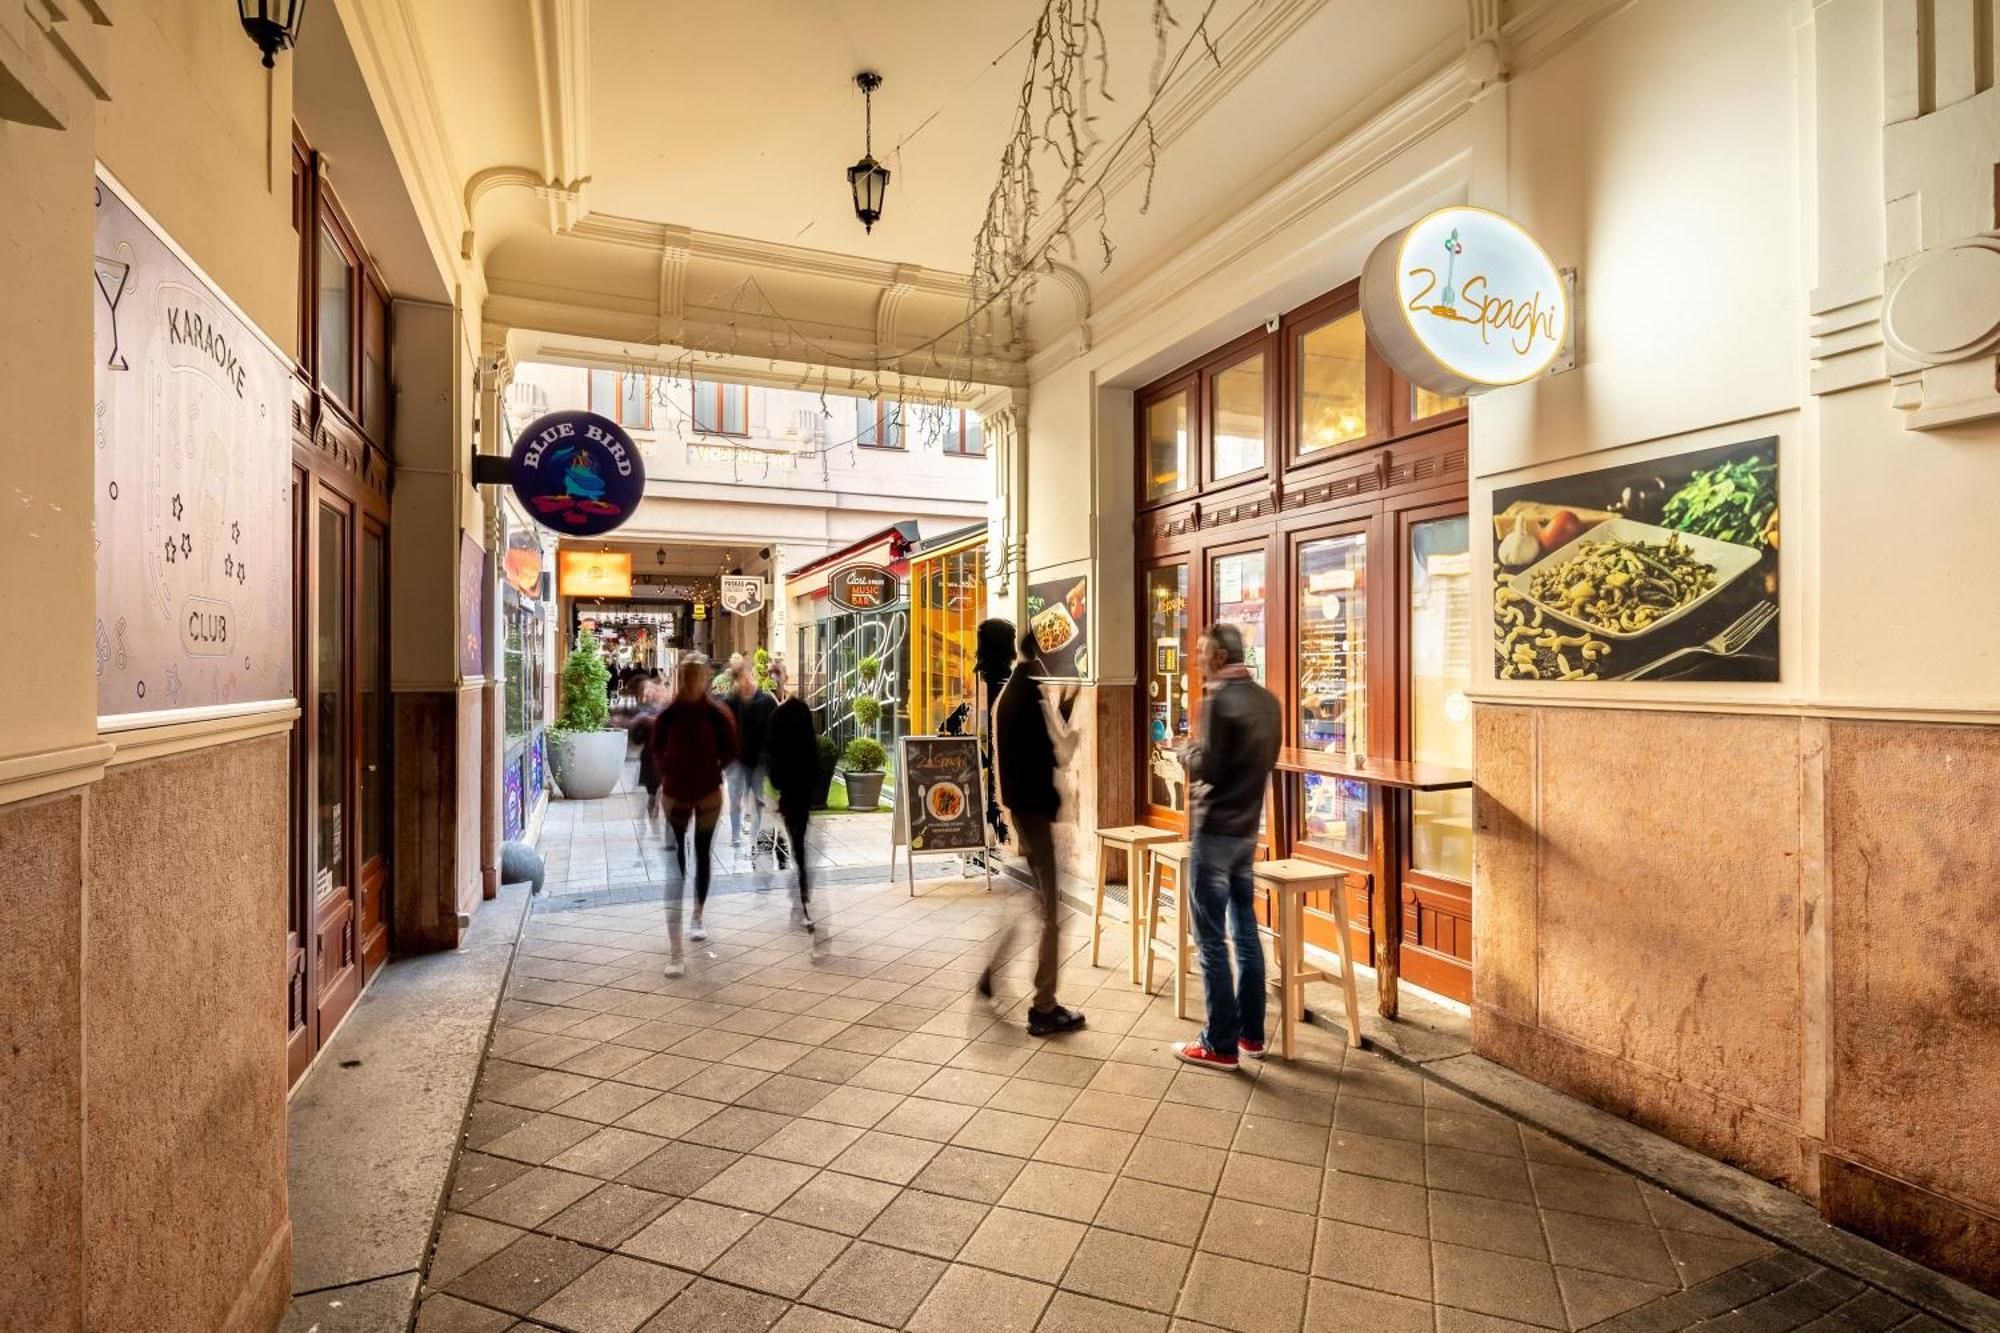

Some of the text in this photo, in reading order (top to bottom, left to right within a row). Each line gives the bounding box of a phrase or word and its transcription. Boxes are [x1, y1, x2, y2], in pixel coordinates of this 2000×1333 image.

[1408, 268, 1556, 356] 2 Spaghi
[167, 307, 246, 400] KARAOKE
[523, 423, 575, 470] BLUE
[584, 424, 632, 476] BIRD
[851, 586, 880, 594] MUSIC
[851, 596, 870, 605] BAR
[189, 611, 226, 642] CLUB
